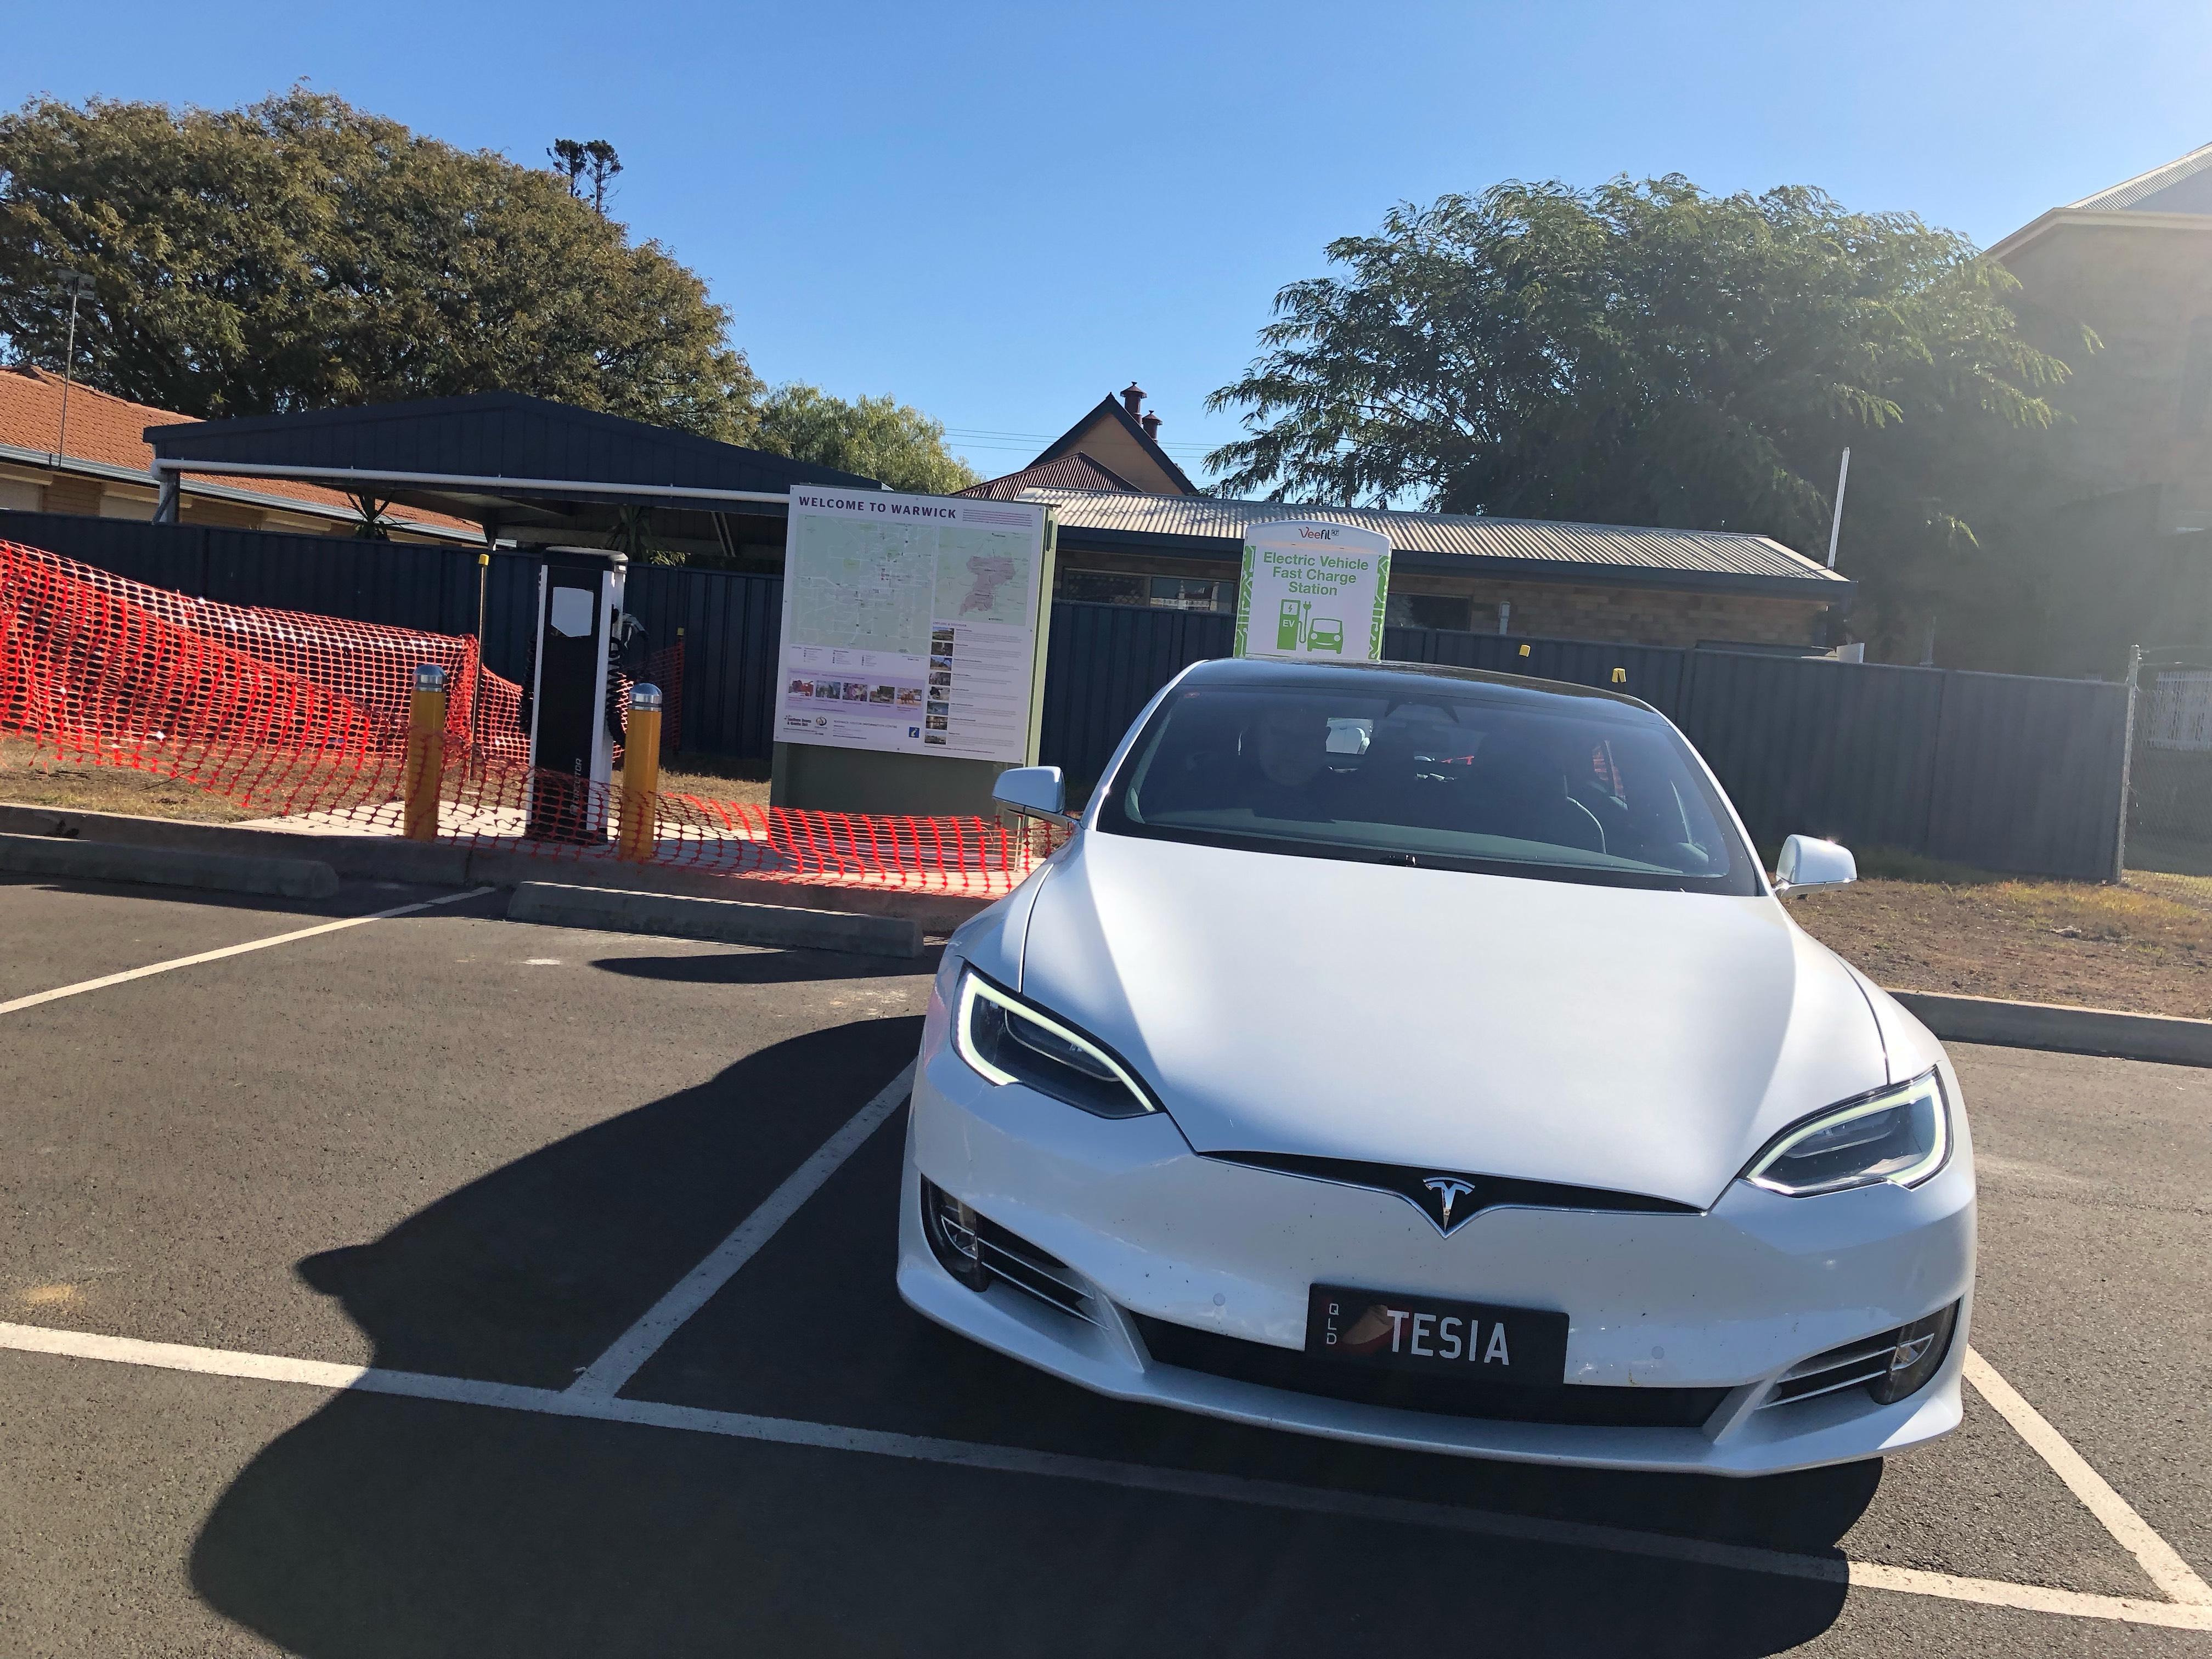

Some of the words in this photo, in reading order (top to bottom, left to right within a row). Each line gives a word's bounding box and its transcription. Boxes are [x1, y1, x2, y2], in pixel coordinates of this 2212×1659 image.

[799, 496, 865, 511] WELCOME
[870, 503, 886, 512] TO
[891, 504, 956, 518] WARWICK
[1299, 527, 1330, 539] Veefil
[1263, 552, 1316, 566] Electric
[1320, 556, 1368, 571] Vehicle
[1273, 566, 1302, 579] Fast
[1306, 569, 1357, 585] Charge
[1288, 582, 1338, 596] Station
[1282, 619, 1295, 628] EV
[1326, 1303, 1339, 1345] QLD
[1387, 1309, 1509, 1365] TESIA
